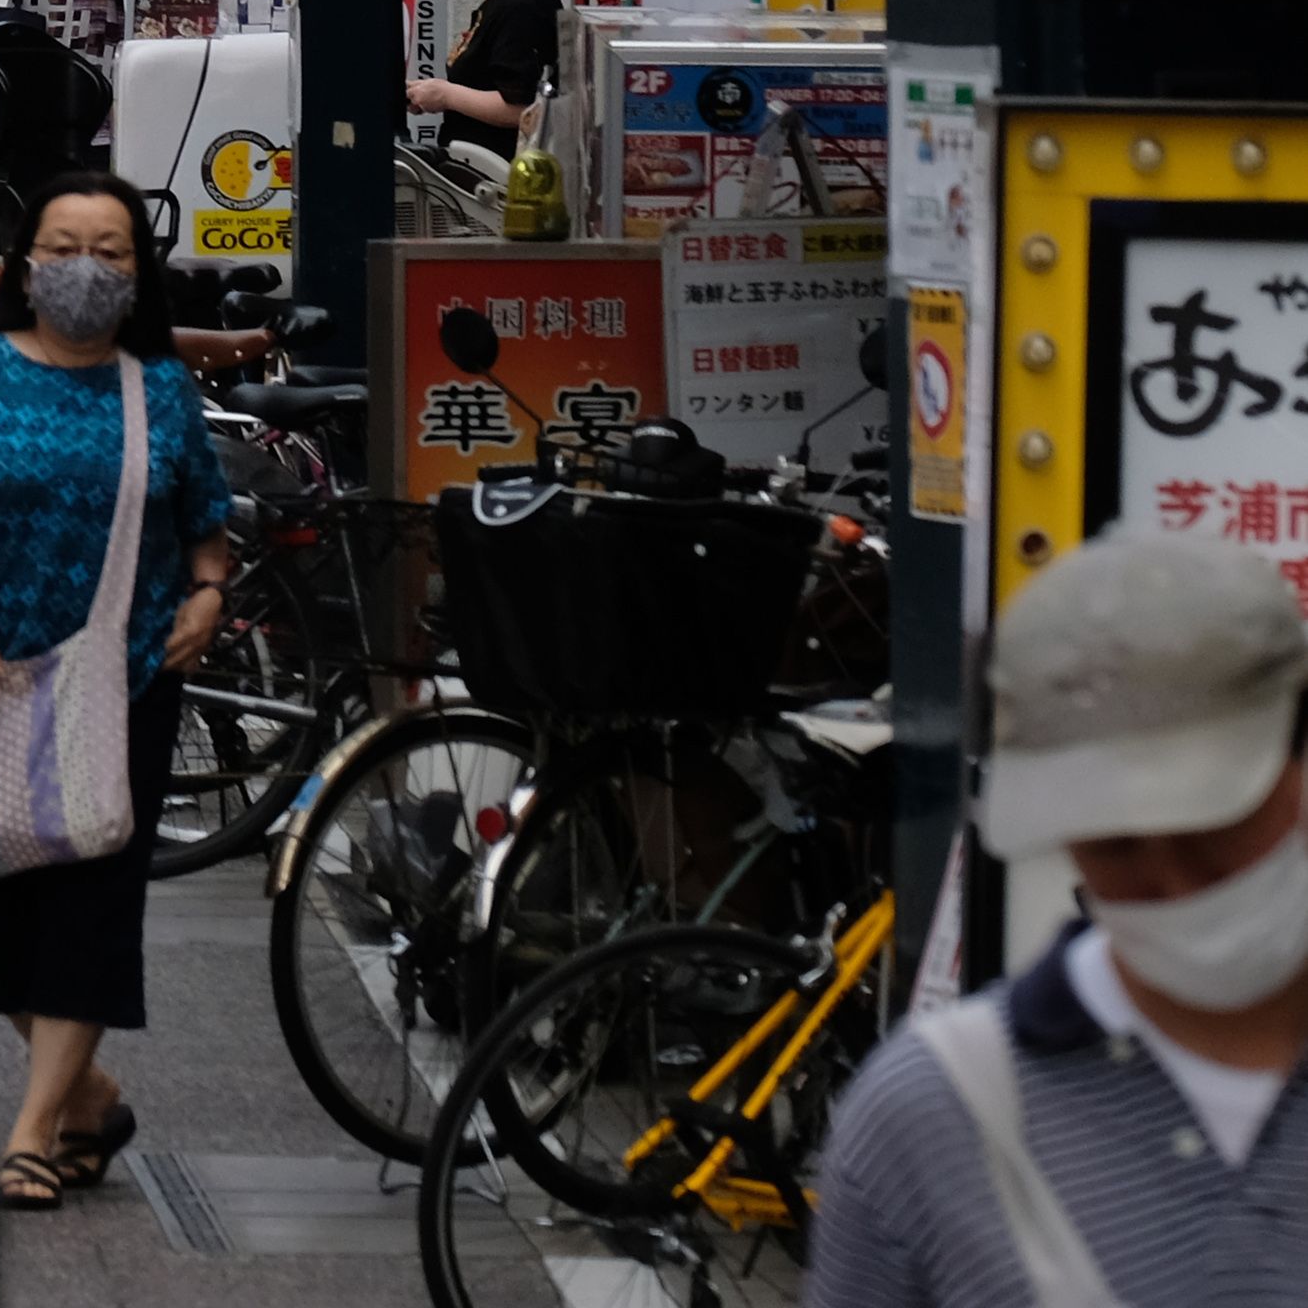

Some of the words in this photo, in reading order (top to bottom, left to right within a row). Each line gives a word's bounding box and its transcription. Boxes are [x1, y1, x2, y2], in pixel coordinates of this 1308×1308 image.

[628, 70, 667, 94] 2F
[683, 233, 788, 262] 日替定食
[437, 297, 627, 340] 国料理
